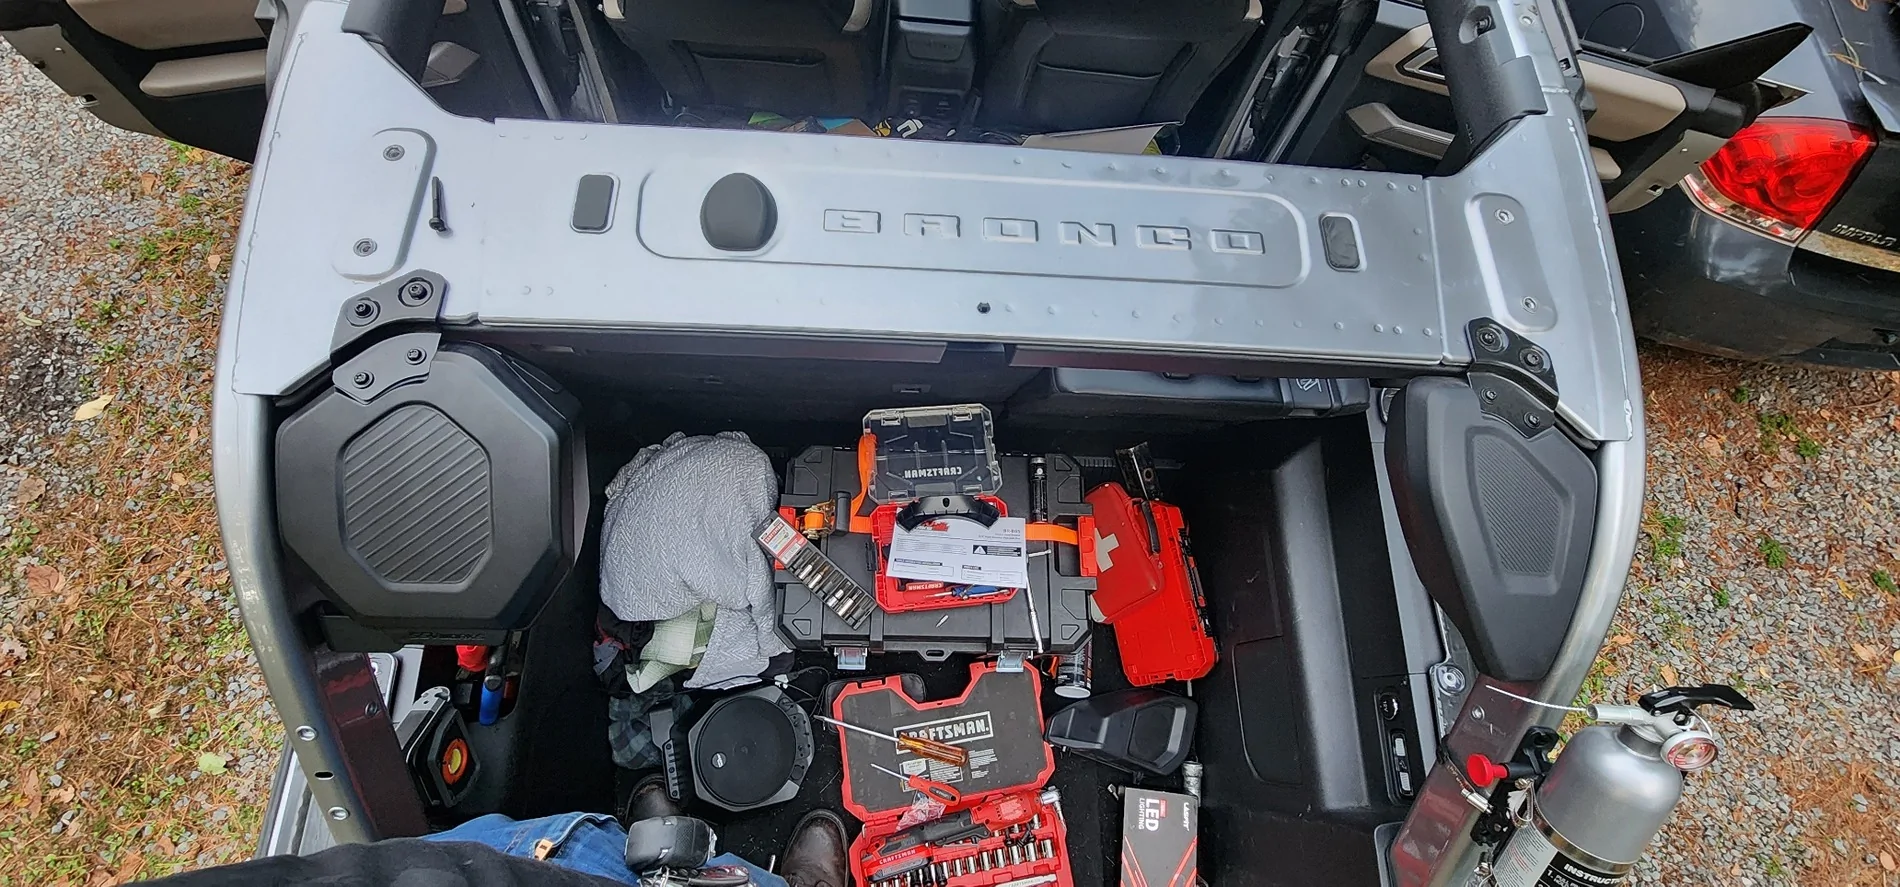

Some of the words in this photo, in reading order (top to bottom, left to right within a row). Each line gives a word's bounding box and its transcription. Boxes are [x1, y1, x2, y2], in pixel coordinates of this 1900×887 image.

[823, 208, 1266, 255] BRONCO
[1830, 223, 1897, 247] IMPALA
[903, 719, 990, 741] RAFTSMAN.
[1145, 798, 1160, 831] LED
[880, 849, 916, 865] CRAFTSMAN
[1563, 863, 1621, 884] INSTRUCT
